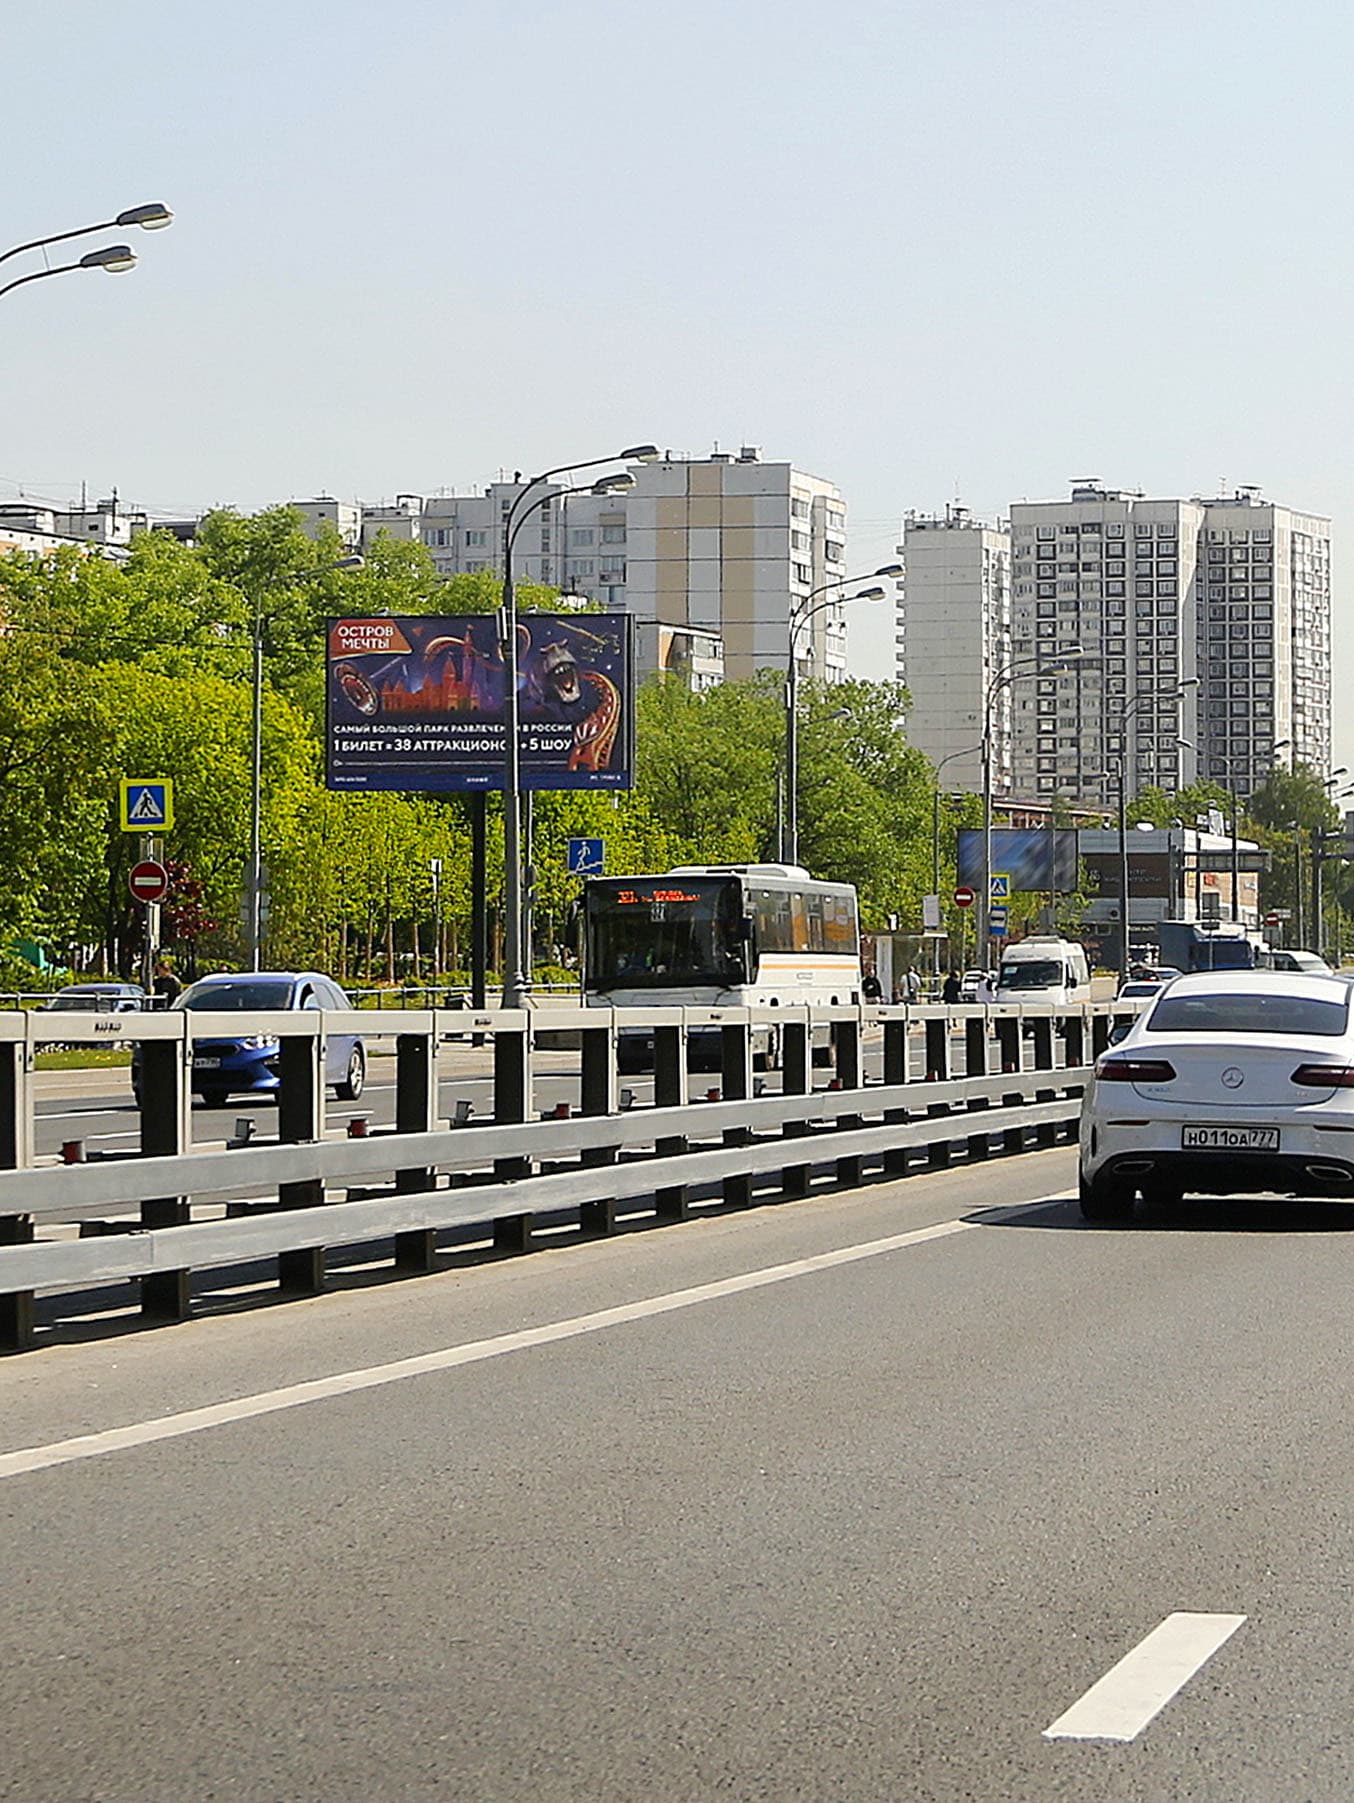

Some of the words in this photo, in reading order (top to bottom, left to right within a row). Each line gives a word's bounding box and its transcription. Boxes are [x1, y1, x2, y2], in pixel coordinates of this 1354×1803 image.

[338, 626, 394, 637] ОСТРОВ
[341, 638, 390, 649] МЕЧТЫ
[333, 723, 370, 733] САМЫЙ
[372, 723, 421, 733] БОЛЬШОЙ
[424, 724, 449, 733] ПАРК
[523, 724, 529, 732] В
[531, 723, 573, 732] РОССИИ
[334, 739, 339, 751] 1
[342, 740, 384, 751] БИЛЕТ
[394, 738, 412, 751] 38
[413, 739, 506, 752] АТТРАКЦИОНО
[529, 737, 538, 750] 5
[541, 739, 573, 751] ШОУ
